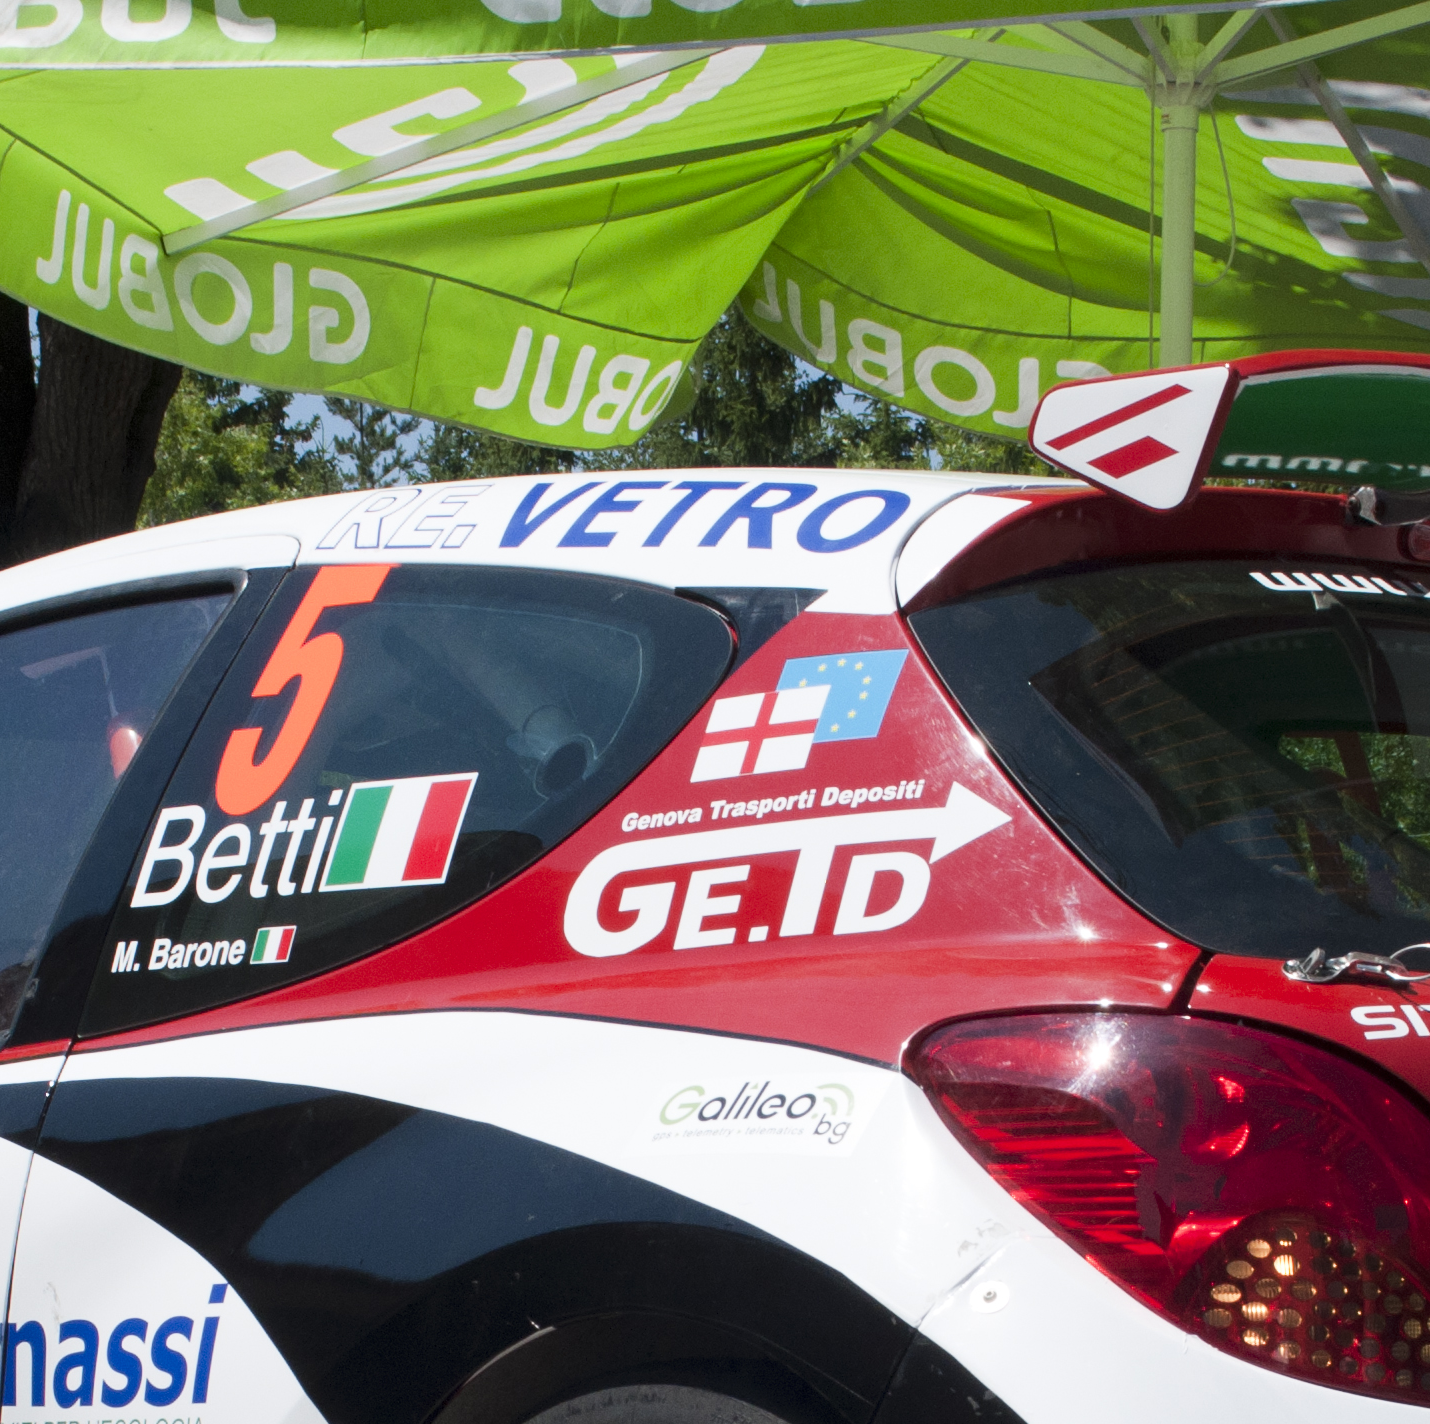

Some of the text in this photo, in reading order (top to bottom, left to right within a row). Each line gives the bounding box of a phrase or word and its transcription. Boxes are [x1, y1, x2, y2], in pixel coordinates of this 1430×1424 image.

[501, 480, 912, 554] VETRO
[215, 564, 399, 815] 5
[621, 780, 924, 833] Genova Trasporti Depositi
[131, 787, 343, 909] Betti
[111, 934, 246, 974] M. Barone
